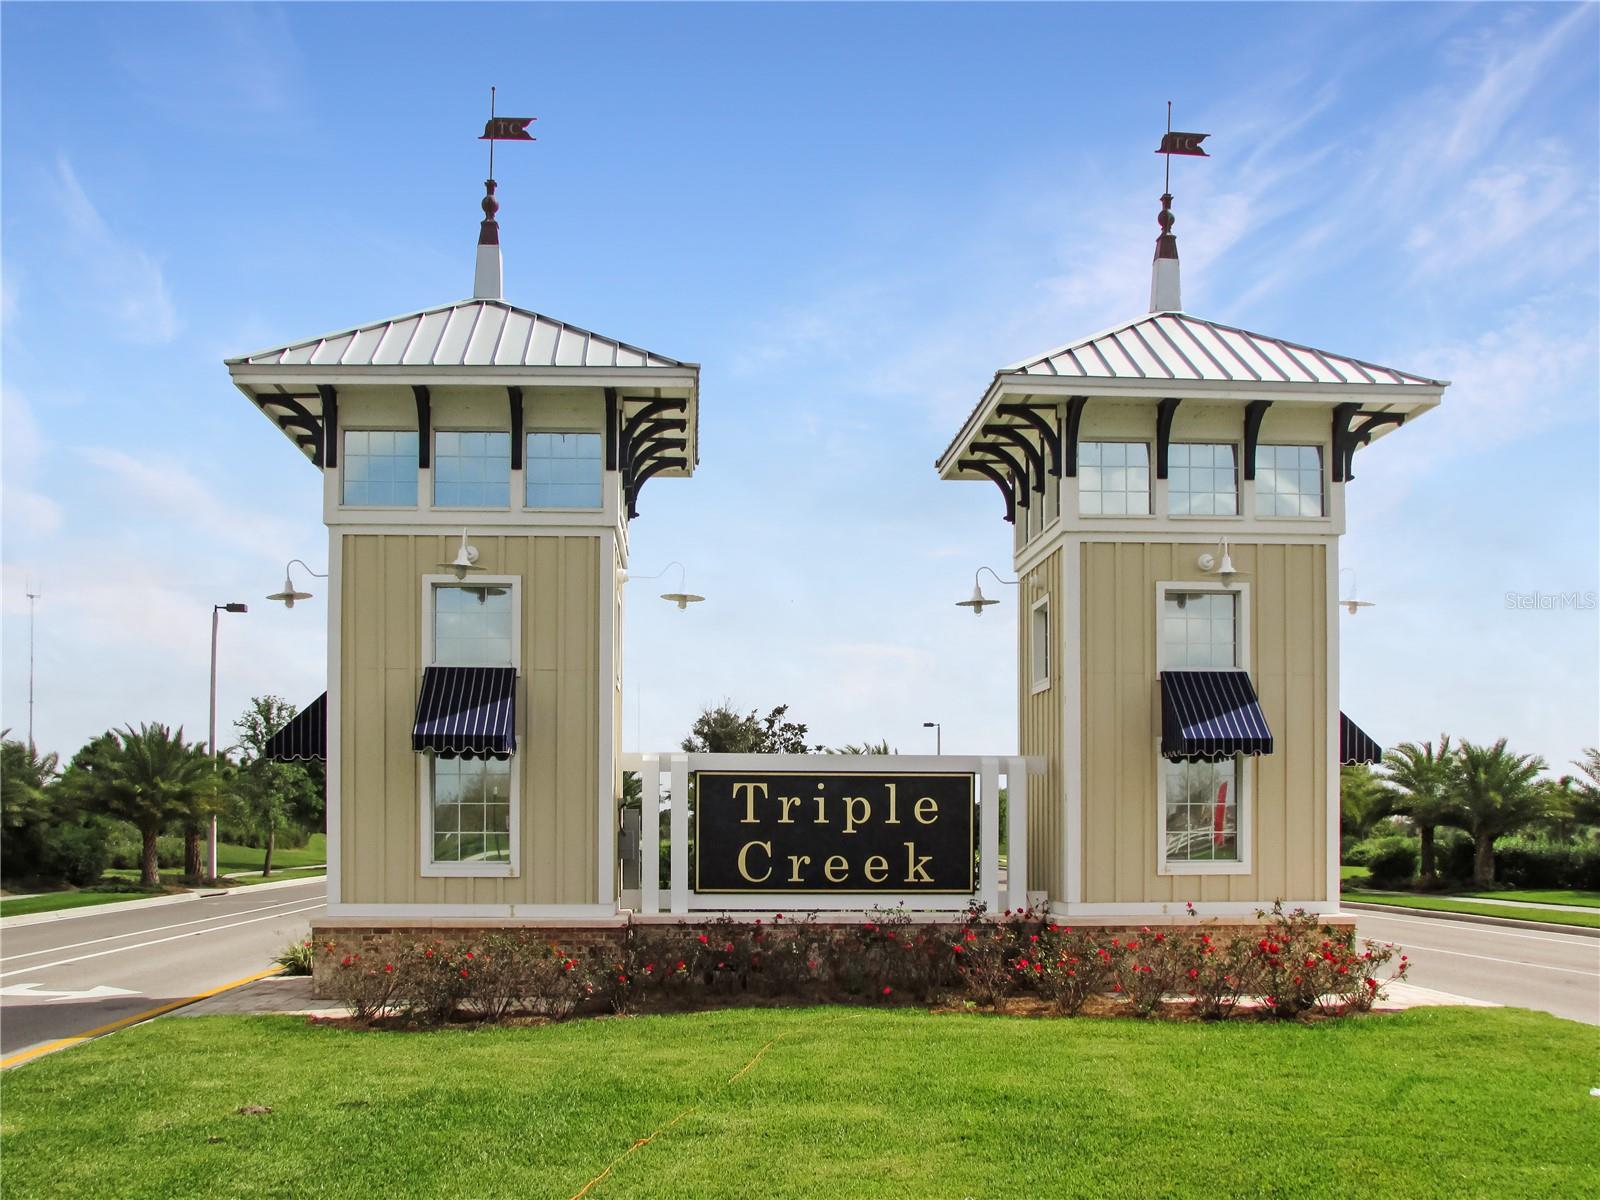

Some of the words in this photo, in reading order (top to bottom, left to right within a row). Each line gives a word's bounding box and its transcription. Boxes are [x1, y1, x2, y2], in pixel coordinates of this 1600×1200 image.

[497, 119, 522, 135] TC
[732, 782, 939, 833] Triple
[737, 840, 935, 883] Creek
